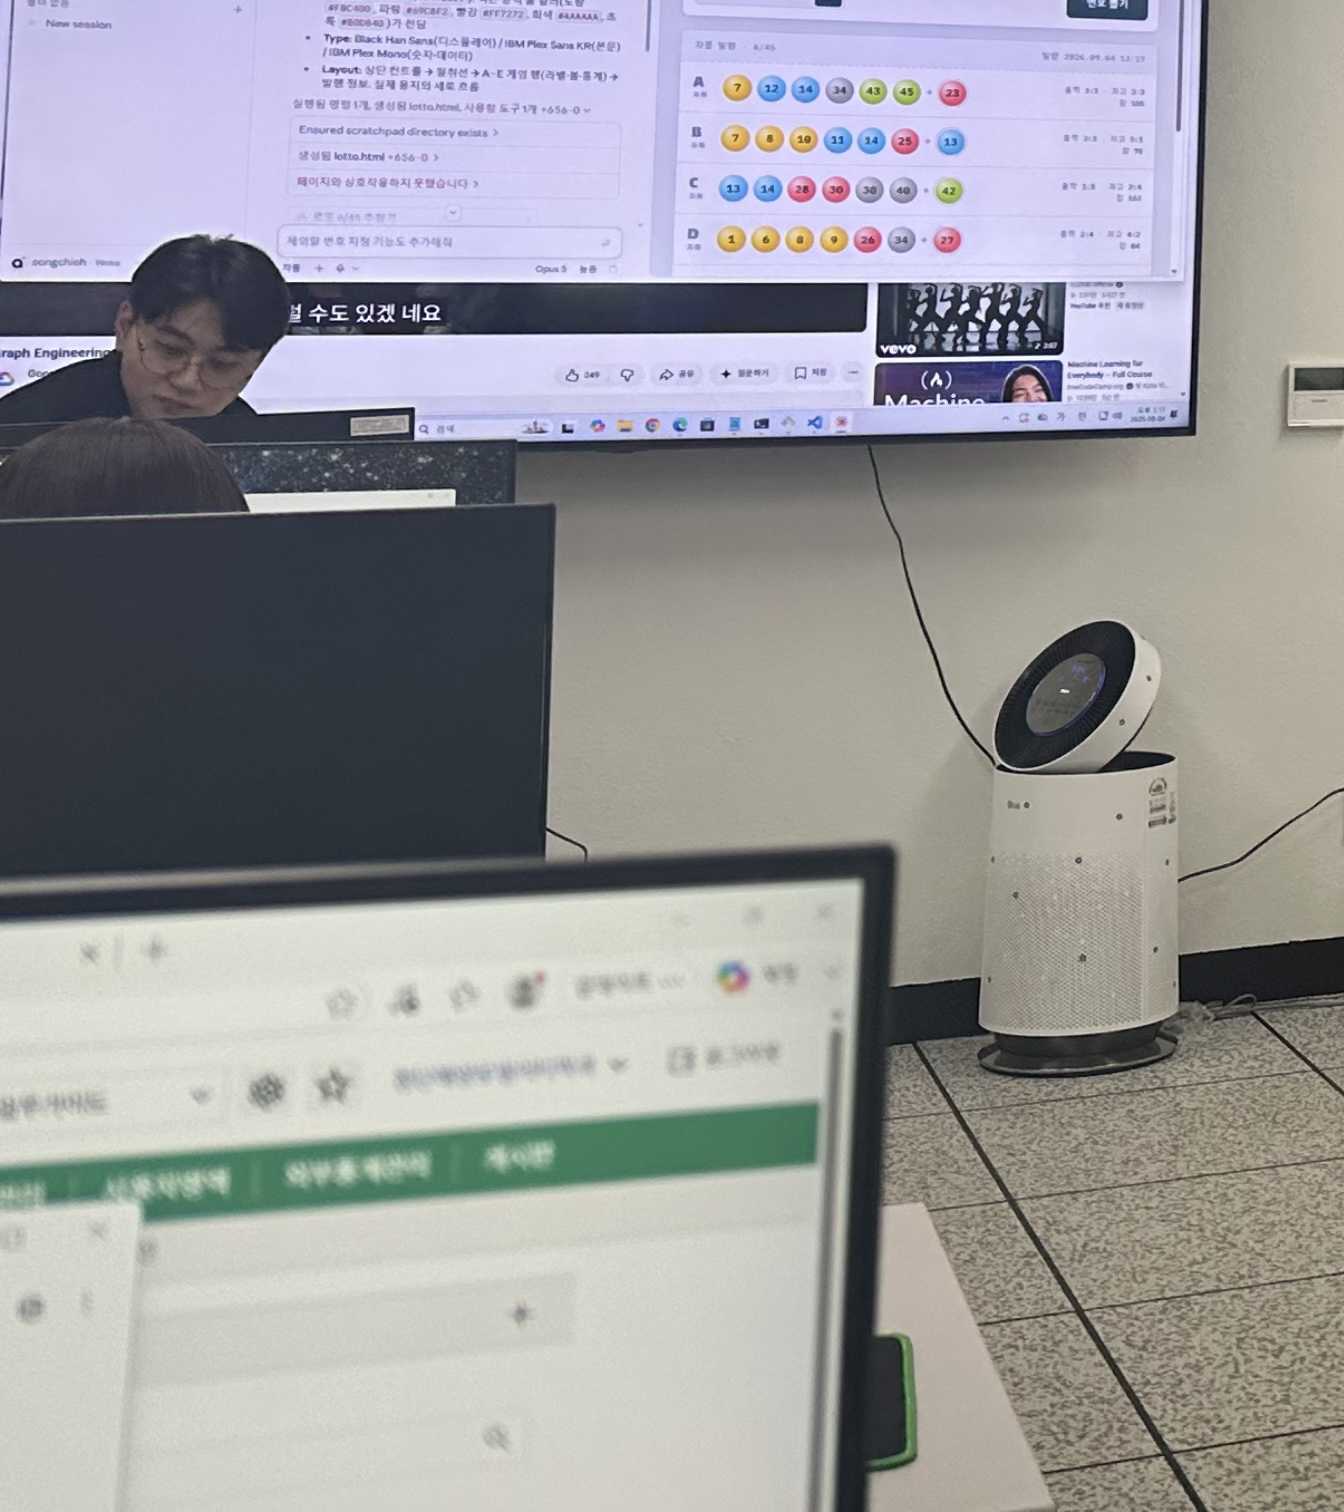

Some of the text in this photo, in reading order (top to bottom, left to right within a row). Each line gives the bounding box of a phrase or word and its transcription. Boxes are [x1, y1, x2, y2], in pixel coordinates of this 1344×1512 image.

[46, 19, 112, 29] New session
[323, 33, 351, 46] Type:
[354, 34, 384, 45] Black
[386, 36, 407, 46] Han
[329, 47, 351, 58] IBM
[352, 48, 375, 59] Plex
[322, 65, 362, 76] Layout:
[733, 82, 742, 93] 7
[763, 84, 780, 94] 12
[797, 84, 814, 94] 14
[831, 85, 848, 95] 34
[866, 86, 882, 96] 43
[898, 87, 915, 97] 45
[945, 88, 960, 98] 23
[299, 124, 488, 139] Ensured scratchpad directory exists
[731, 133, 740, 143] 7
[765, 134, 774, 143] 8
[796, 134, 812, 144] 10
[830, 135, 846, 145] 11
[863, 136, 879, 145] 14
[897, 136, 913, 146] 25
[943, 137, 958, 146] 13
[334, 151, 386, 162] lotto.html
[388, 152, 416, 162] +656
[726, 183, 741, 193] 13
[760, 184, 775, 194] 14
[795, 184, 810, 194] 28
[828, 185, 844, 194] 30
[862, 185, 878, 195] 38
[895, 185, 911, 195] 40
[941, 186, 957, 196] 42
[762, 235, 771, 245] 6
[830, 235, 838, 245] 9
[860, 235, 876, 245] 26
[893, 235, 909, 245] 34
[940, 235, 955, 245] 27
[308, 303, 350, 324] 수도
[355, 303, 396, 324] 있겠
[402, 303, 442, 324] 네요
[0, 347, 30, 361] raph
[1127, 370, 1153, 379] Course
